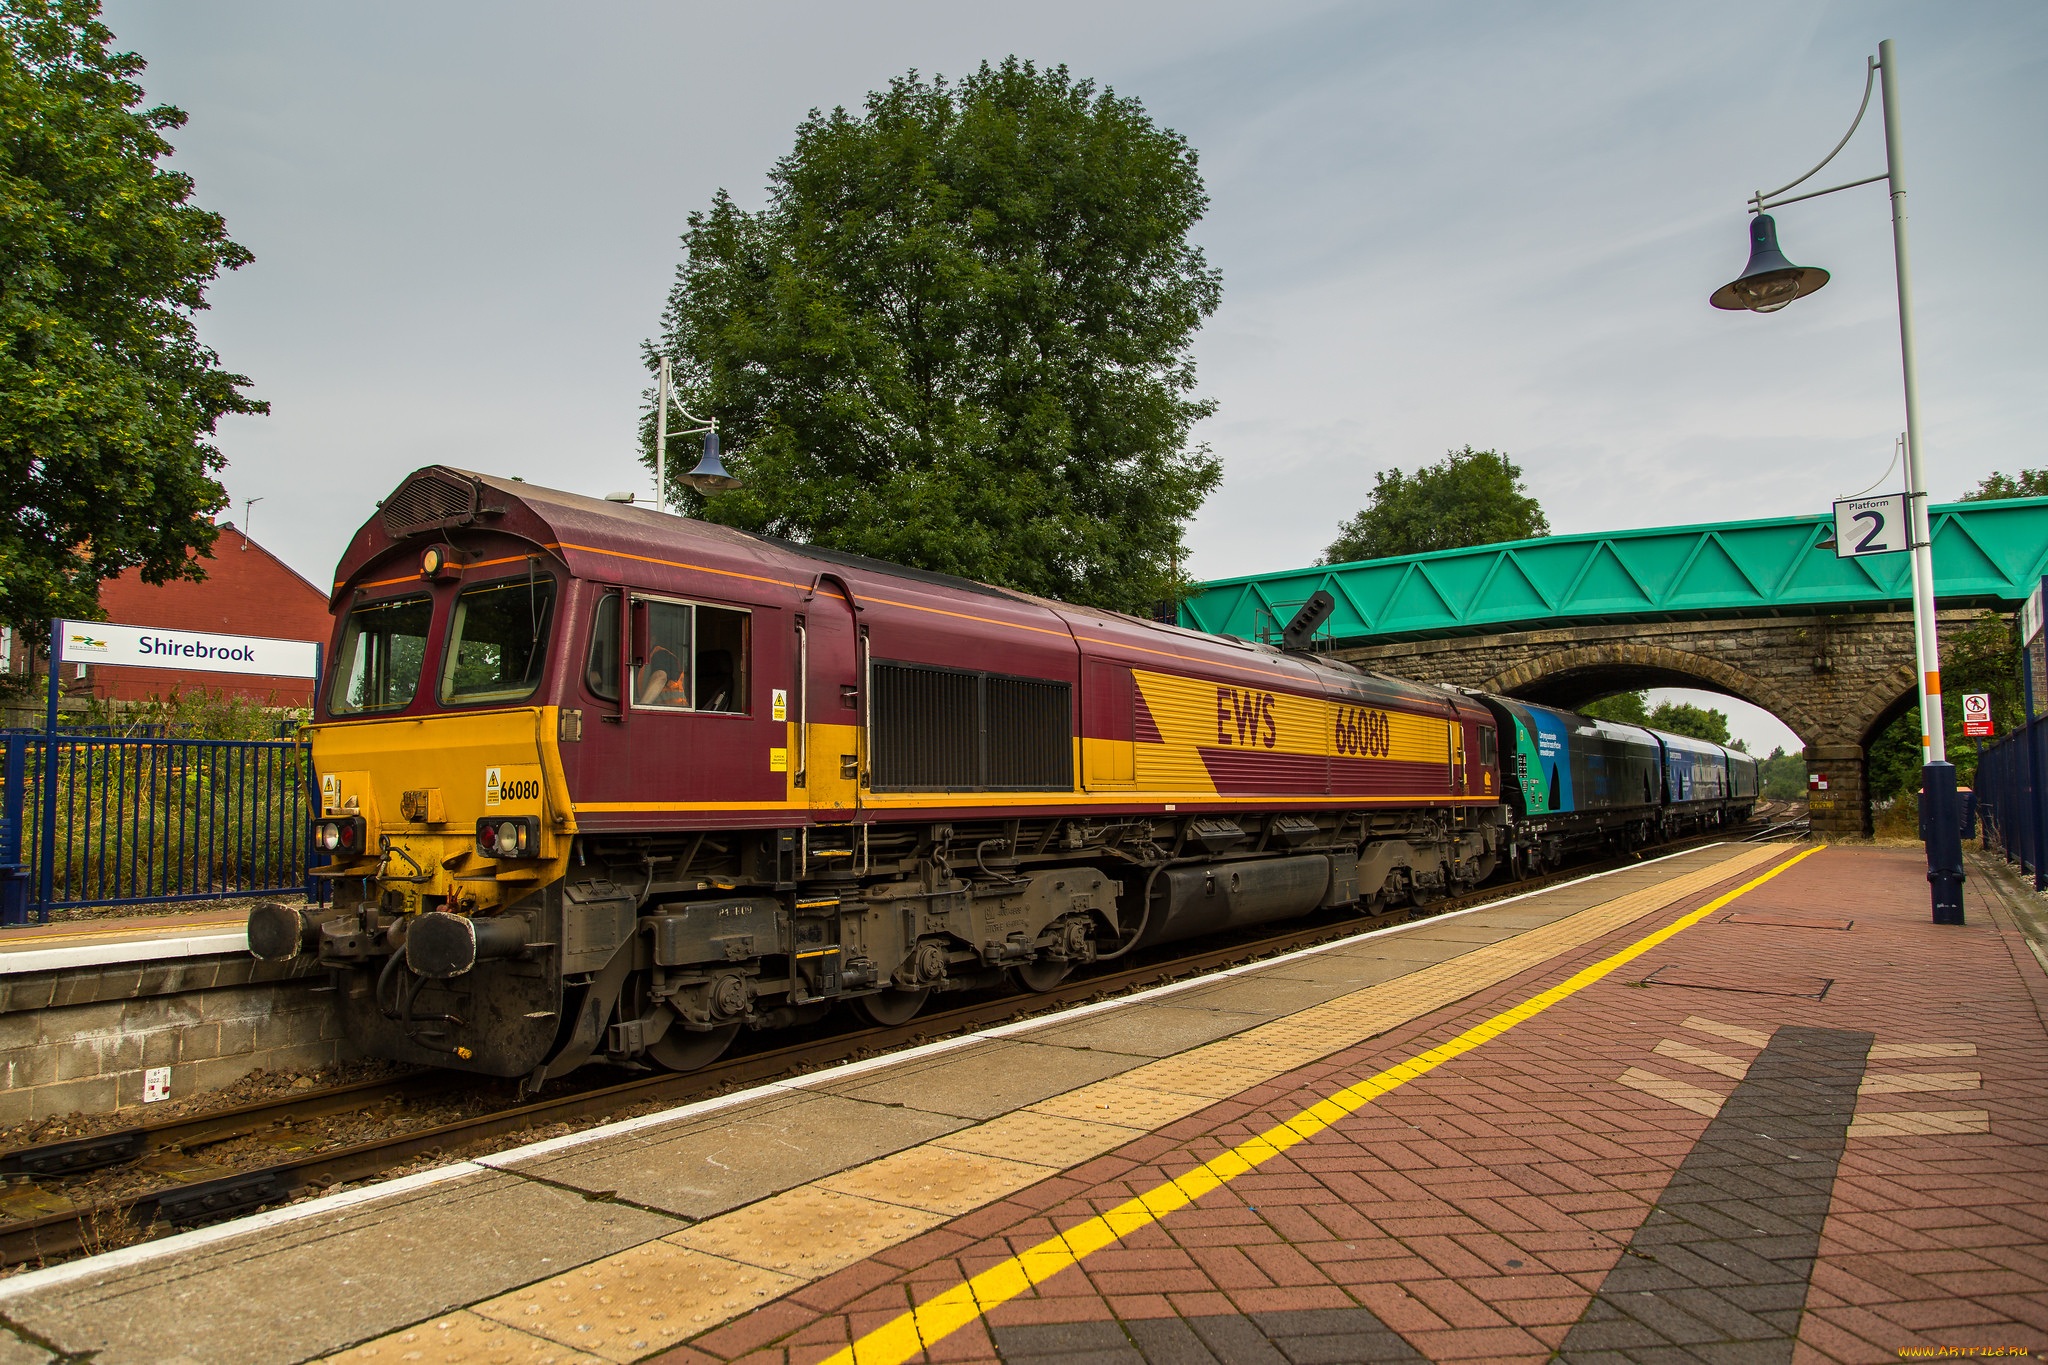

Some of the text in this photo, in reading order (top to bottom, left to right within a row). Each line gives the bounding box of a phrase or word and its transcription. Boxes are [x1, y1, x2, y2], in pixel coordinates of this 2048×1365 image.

[1849, 500, 1889, 511] Platform
[1852, 510, 1888, 553] 2
[139, 635, 255, 662] Shirebrook
[1216, 686, 1277, 749] EWS
[1335, 706, 1390, 758] 66080
[500, 780, 540, 801] 66080
